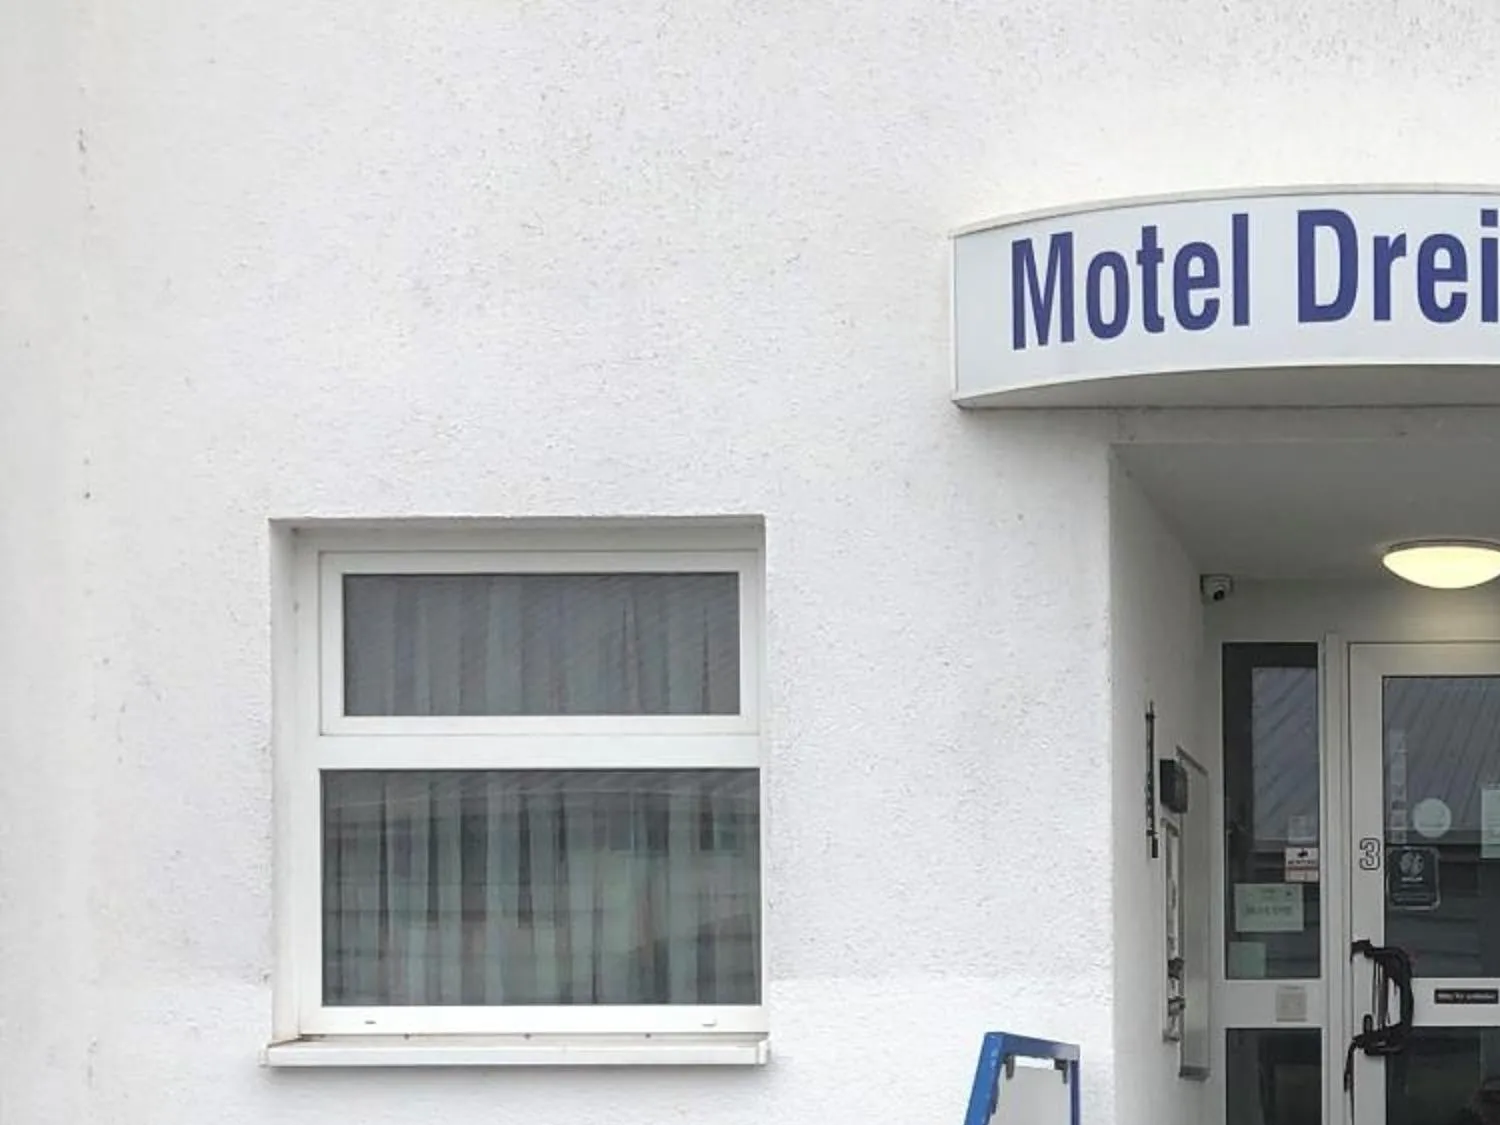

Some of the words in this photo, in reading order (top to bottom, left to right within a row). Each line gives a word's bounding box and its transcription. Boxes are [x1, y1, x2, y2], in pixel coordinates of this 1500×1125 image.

[1012, 212, 1250, 350] Motel
[1296, 208, 1500, 324] Drei
[1359, 838, 1380, 870] 3
